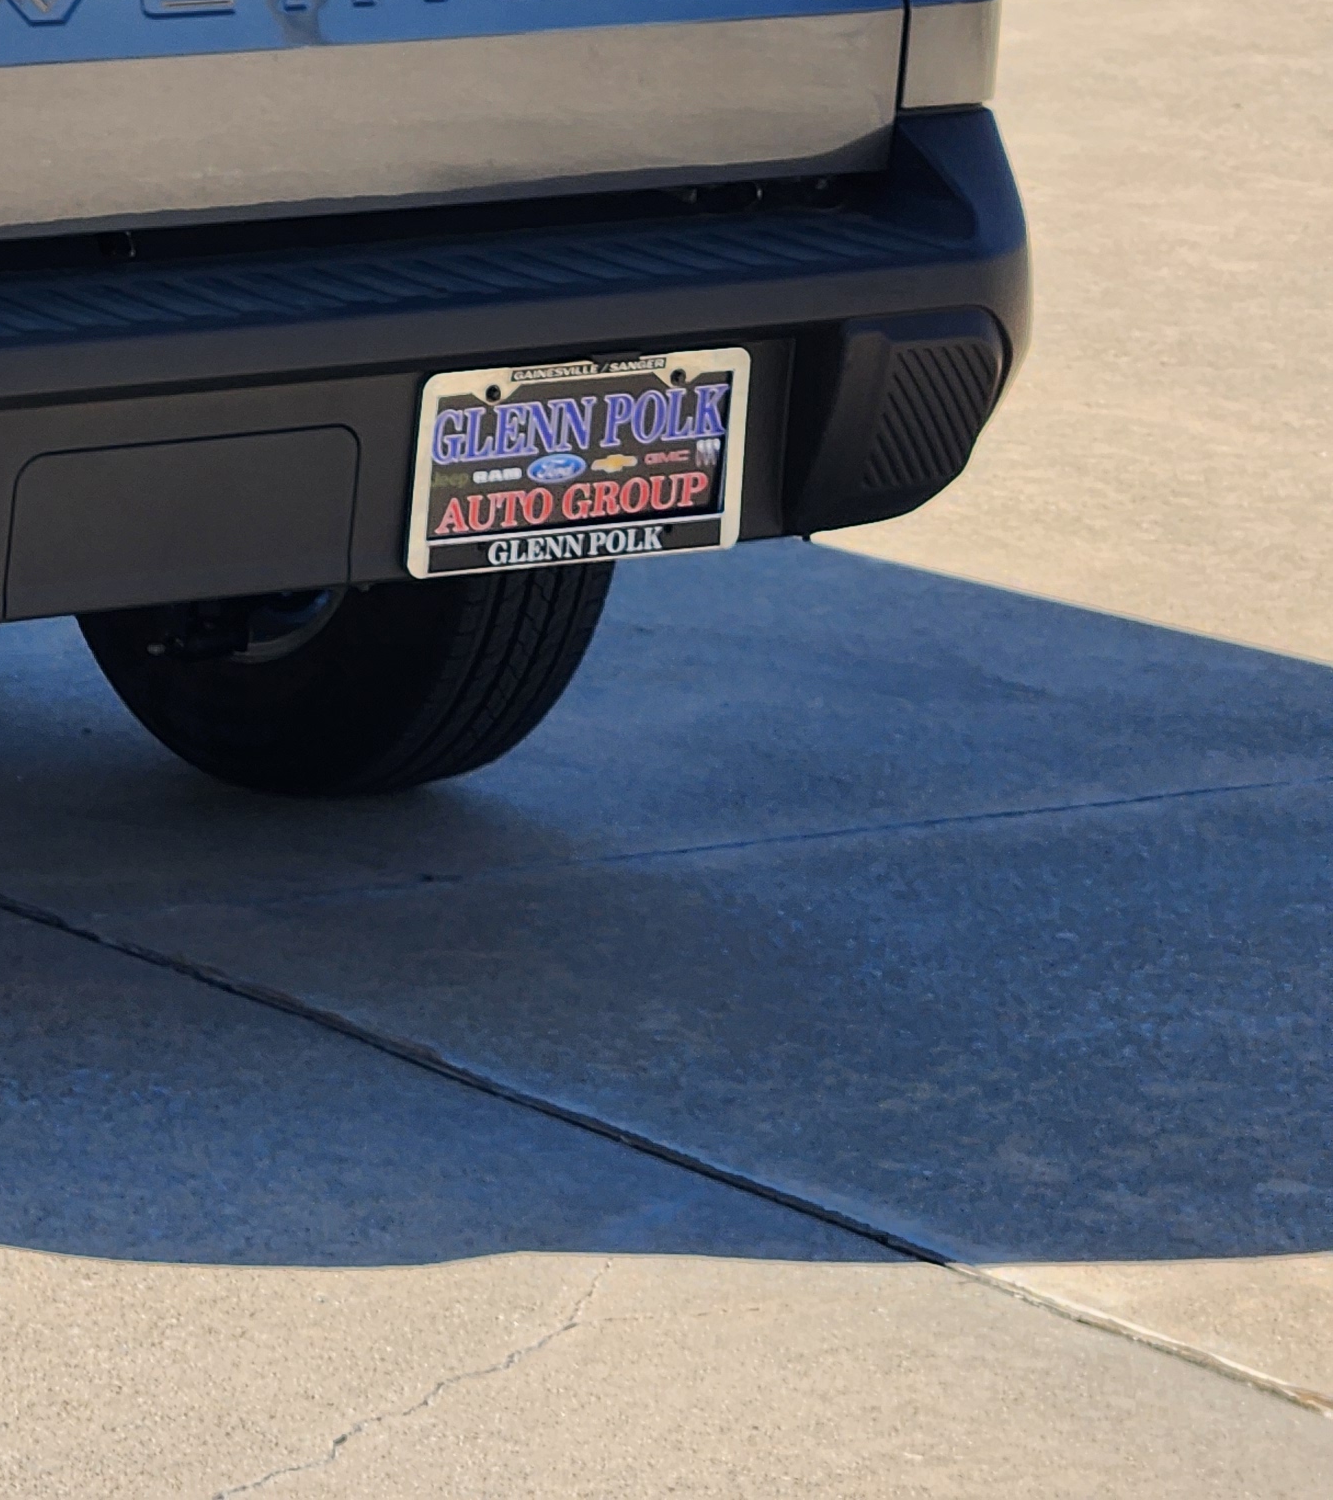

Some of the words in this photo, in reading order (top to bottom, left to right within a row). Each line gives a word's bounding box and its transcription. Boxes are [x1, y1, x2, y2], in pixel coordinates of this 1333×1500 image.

[431, 396, 597, 466] GLENN
[600, 383, 729, 449] POLK
[472, 467, 523, 484] RAM
[644, 449, 691, 466] GMC
[434, 487, 554, 534] AUTO
[562, 472, 709, 519] GROUP
[487, 533, 583, 566] GLENN
[588, 526, 663, 556] POLK
